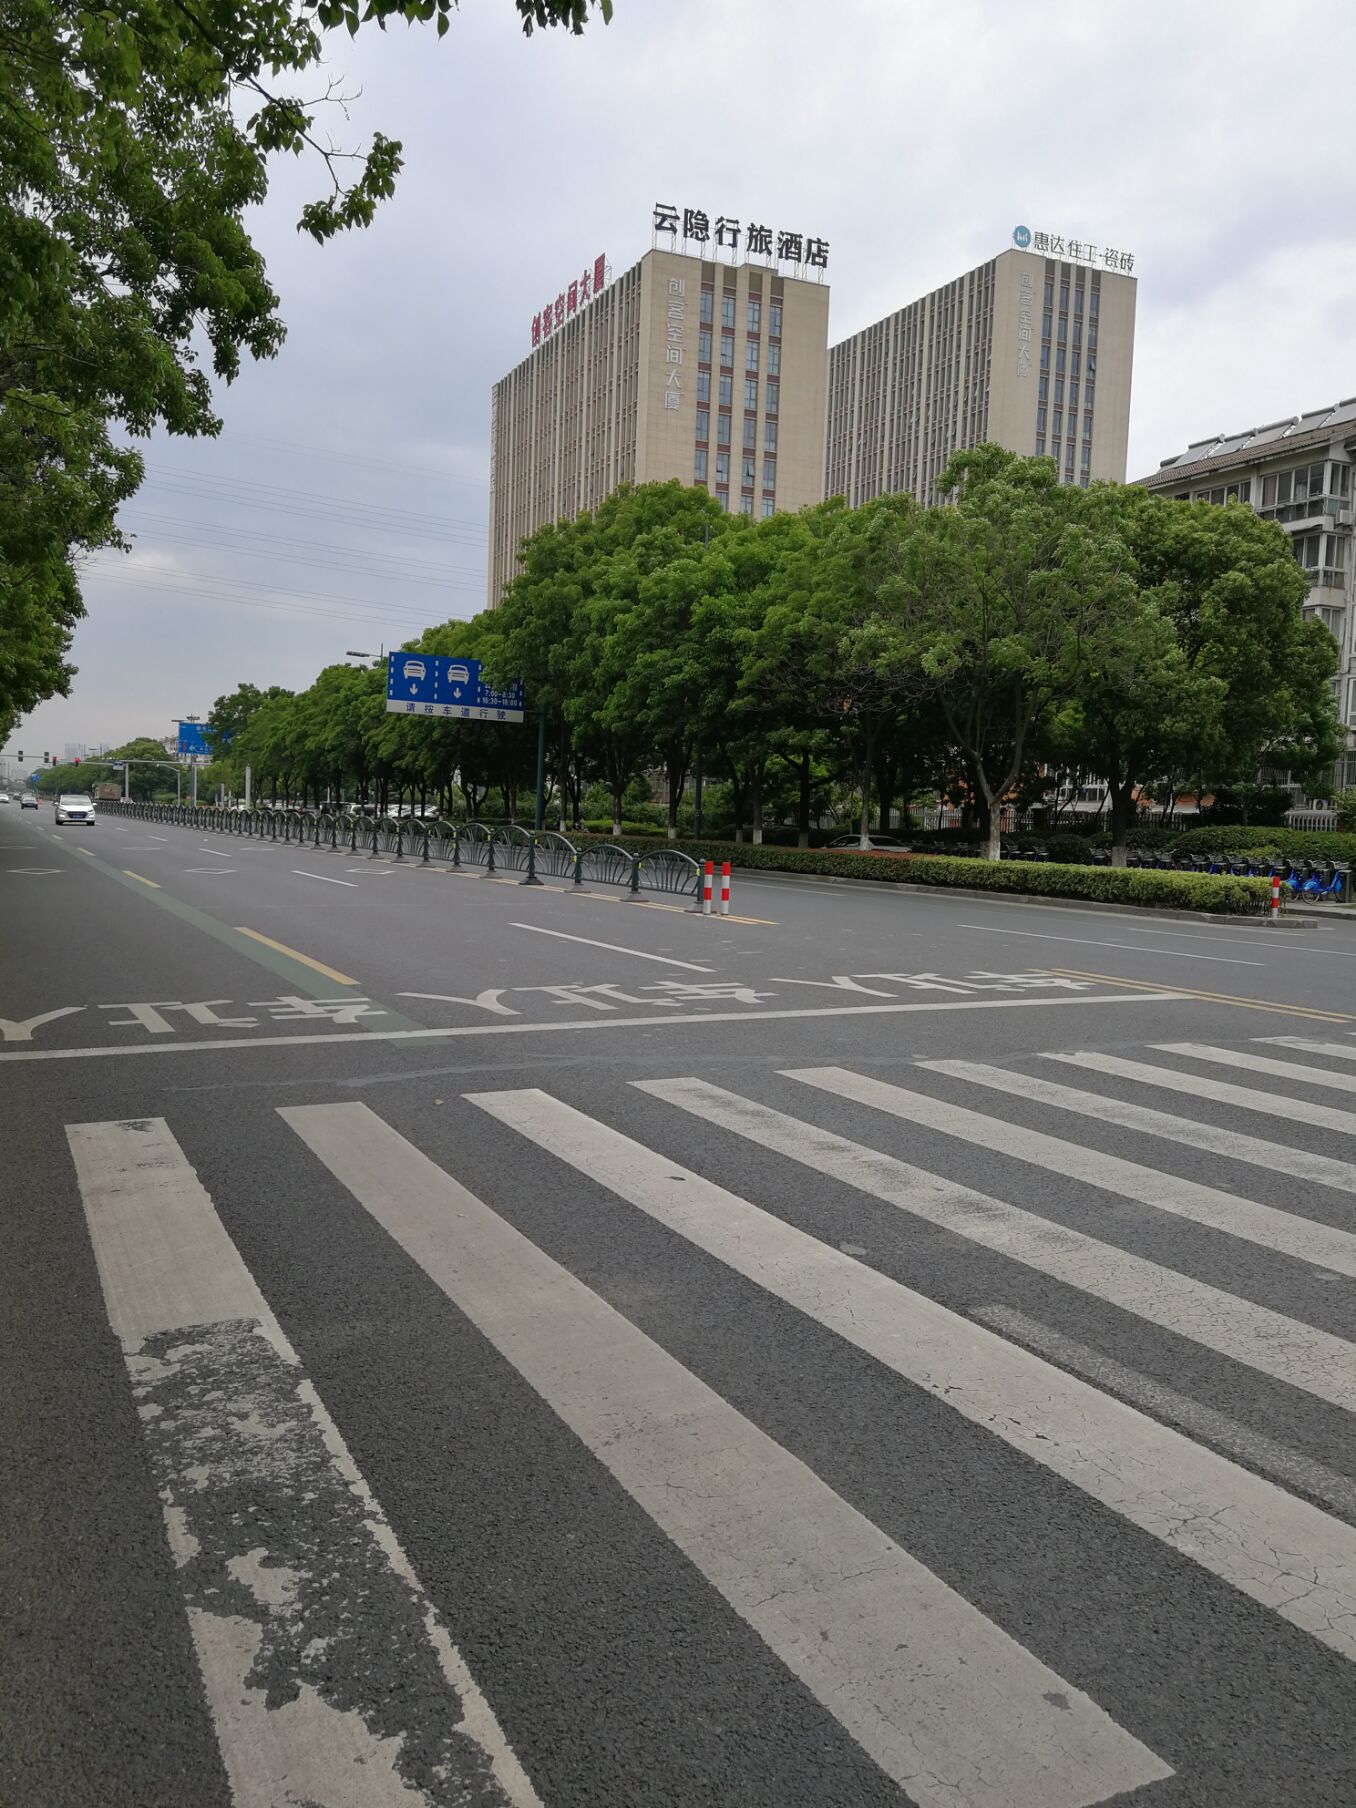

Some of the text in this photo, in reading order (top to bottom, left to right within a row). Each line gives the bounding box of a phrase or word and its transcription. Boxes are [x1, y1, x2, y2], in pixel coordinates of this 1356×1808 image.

[653, 202, 829, 268] 云隐行旅酒店
[664, 277, 686, 412] 创客空间大厦
[406, 703, 506, 720] 请按车道行驶
